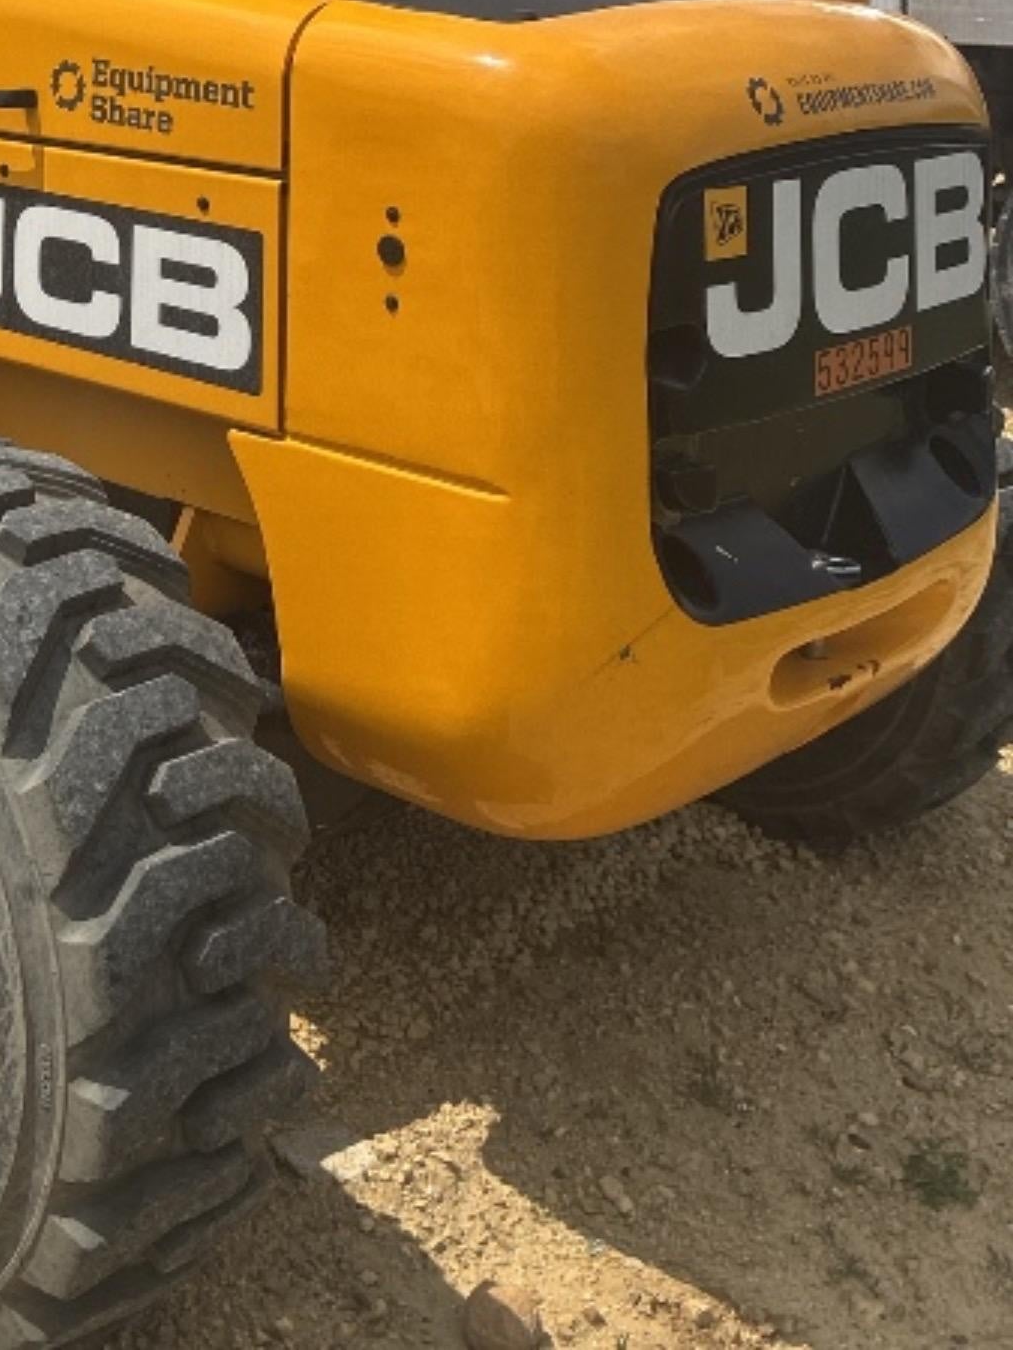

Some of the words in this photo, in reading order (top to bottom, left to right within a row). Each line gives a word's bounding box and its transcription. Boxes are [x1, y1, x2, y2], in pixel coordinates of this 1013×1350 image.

[91, 58, 255, 110] Equipment
[91, 96, 174, 134] Share
[705, 150, 988, 359] JCB
